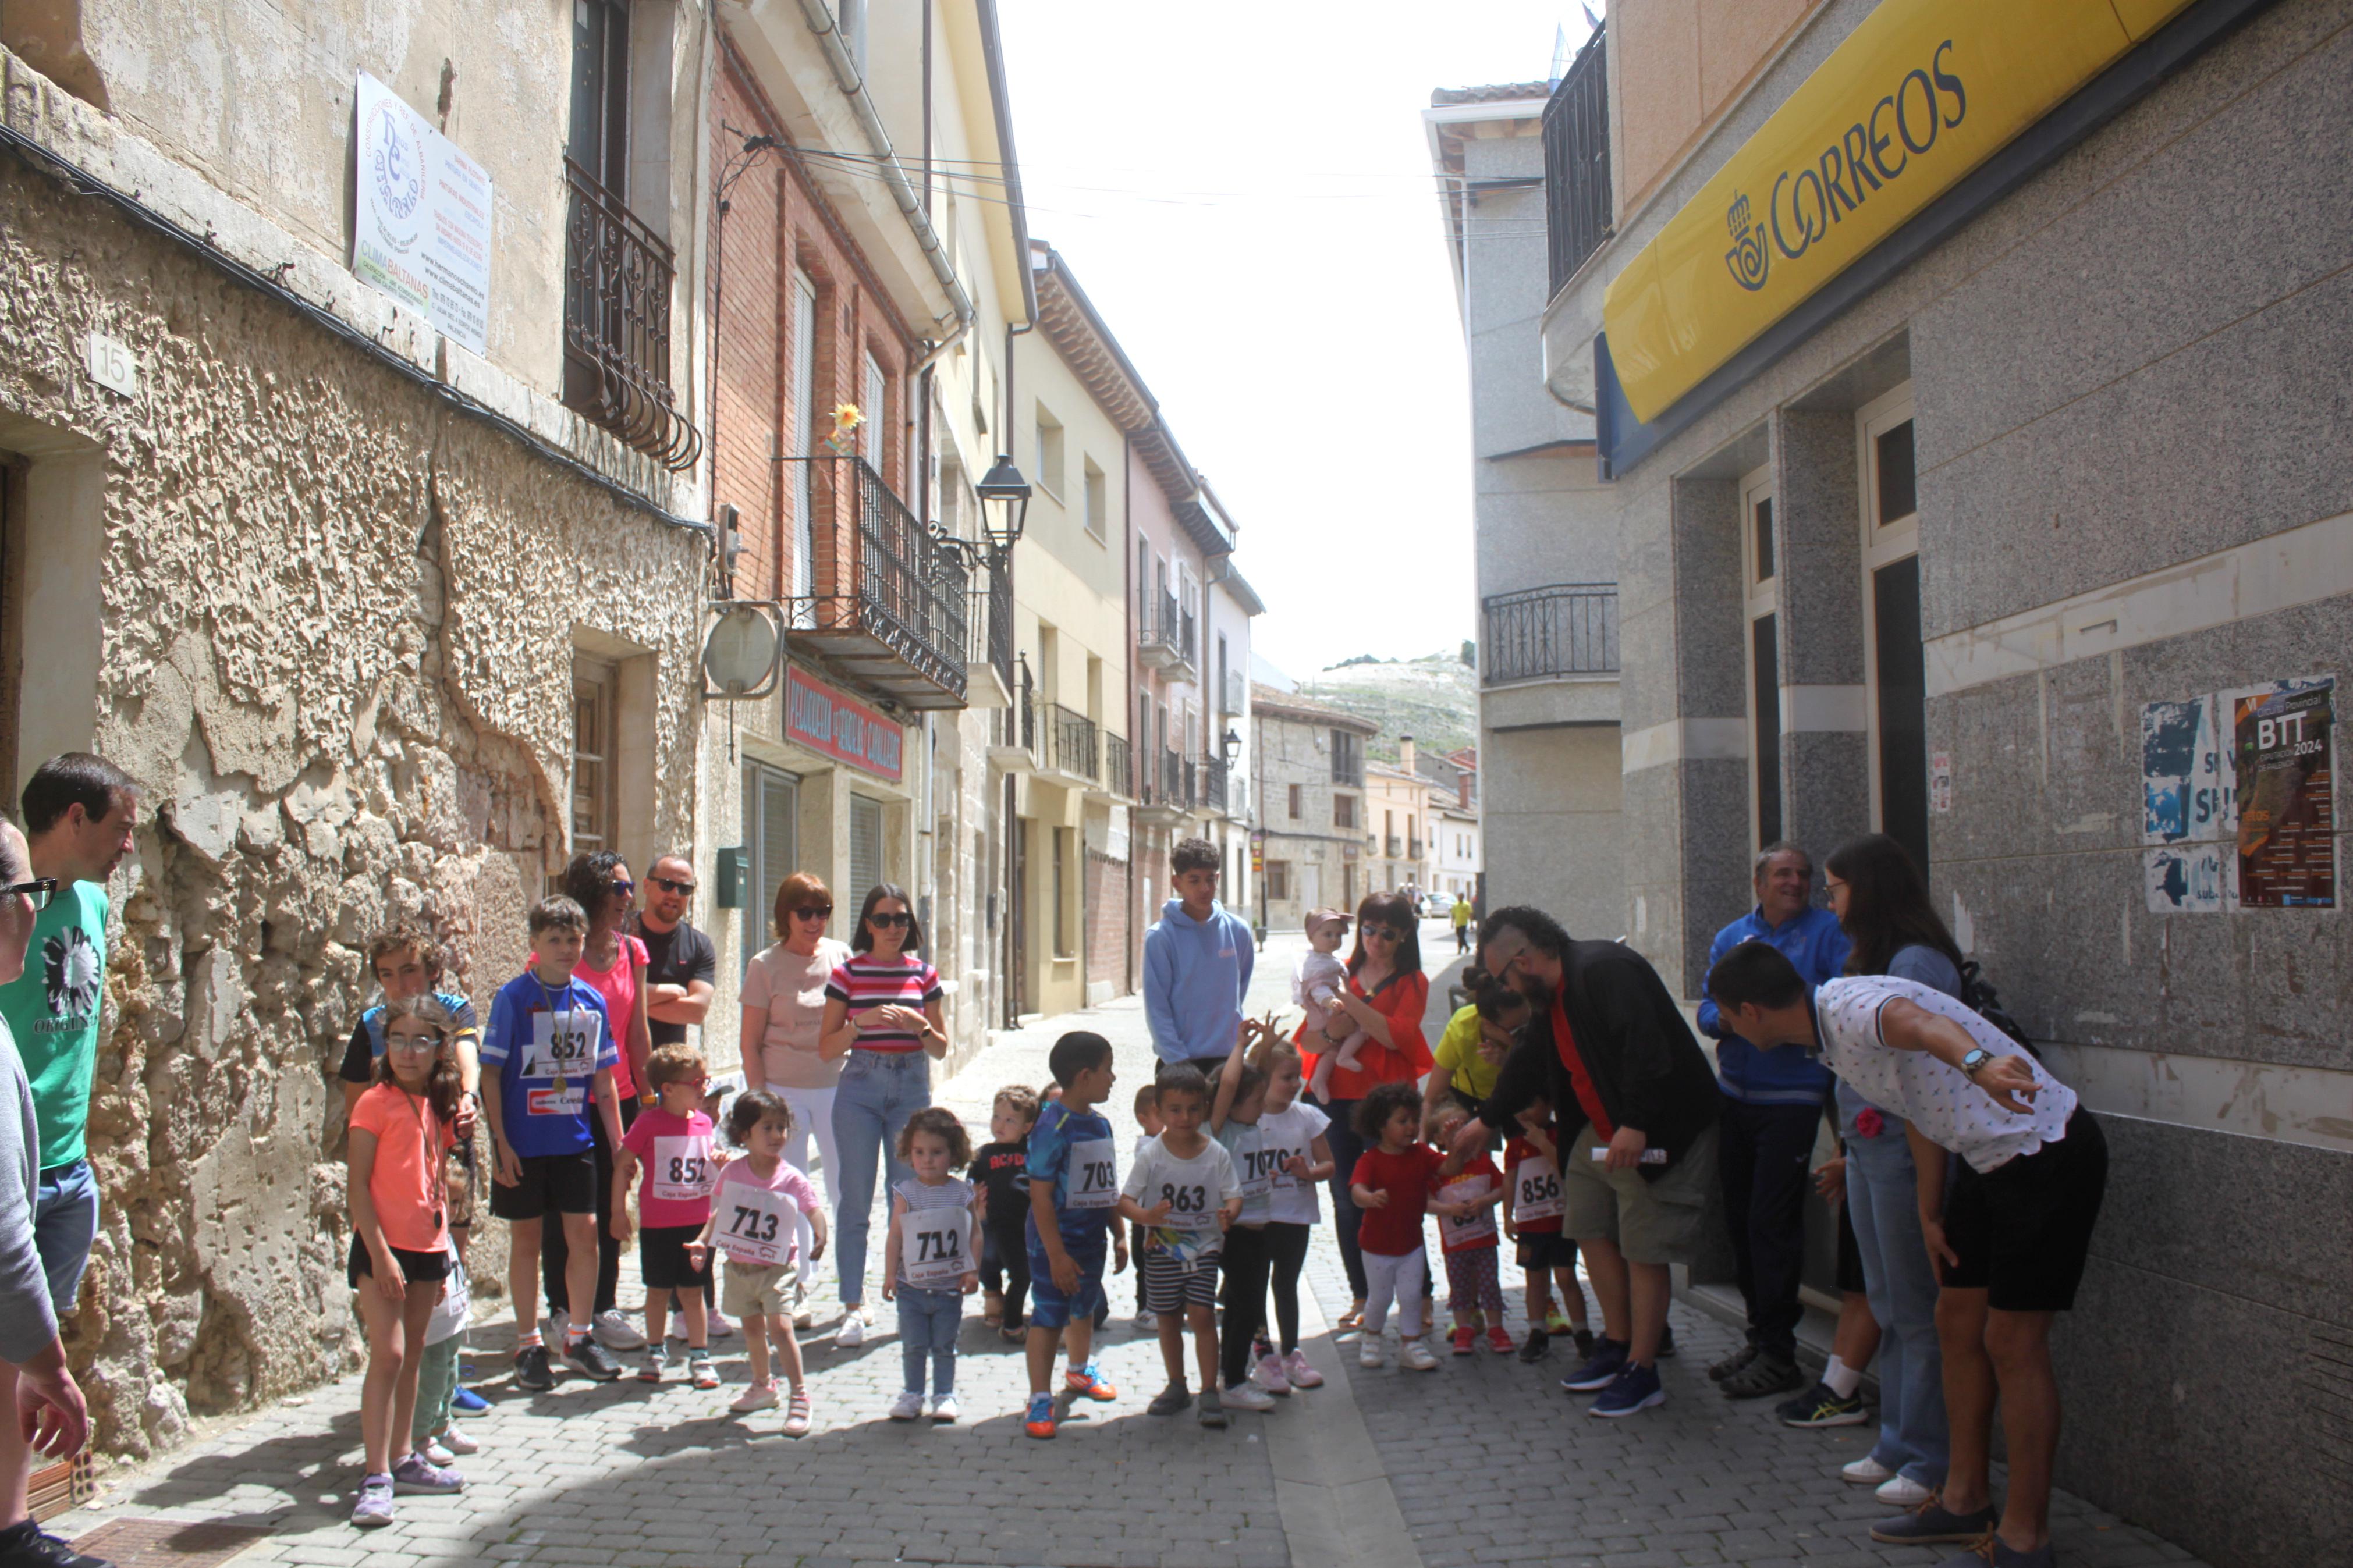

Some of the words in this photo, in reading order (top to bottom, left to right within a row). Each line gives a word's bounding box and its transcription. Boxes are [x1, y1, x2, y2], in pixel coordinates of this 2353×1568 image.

[1770, 39, 1967, 260] CORREOS
[361, 239, 428, 300] CLIMABALTANAS
[100, 343, 126, 384] 15
[790, 678, 832, 744] PELUQUERIA
[2246, 697, 2257, 712] VI
[2285, 694, 2322, 710] Provincial
[2258, 710, 2308, 750] BTT
[2294, 739, 2323, 756] 2024
[551, 1031, 587, 1059] 852
[1083, 1161, 1115, 1192] 703
[1522, 1173, 1559, 1204] 856
[662, 1190, 676, 1199] Caja
[1073, 1199, 1087, 1208] Caja
[1089, 1199, 1110, 1208] España
[1161, 1183, 1205, 1213] 863
[730, 1205, 779, 1242] 713
[715, 1239, 730, 1249] Caja
[732, 1244, 755, 1256] España
[917, 1228, 959, 1262] 712
[926, 1268, 949, 1277] España
